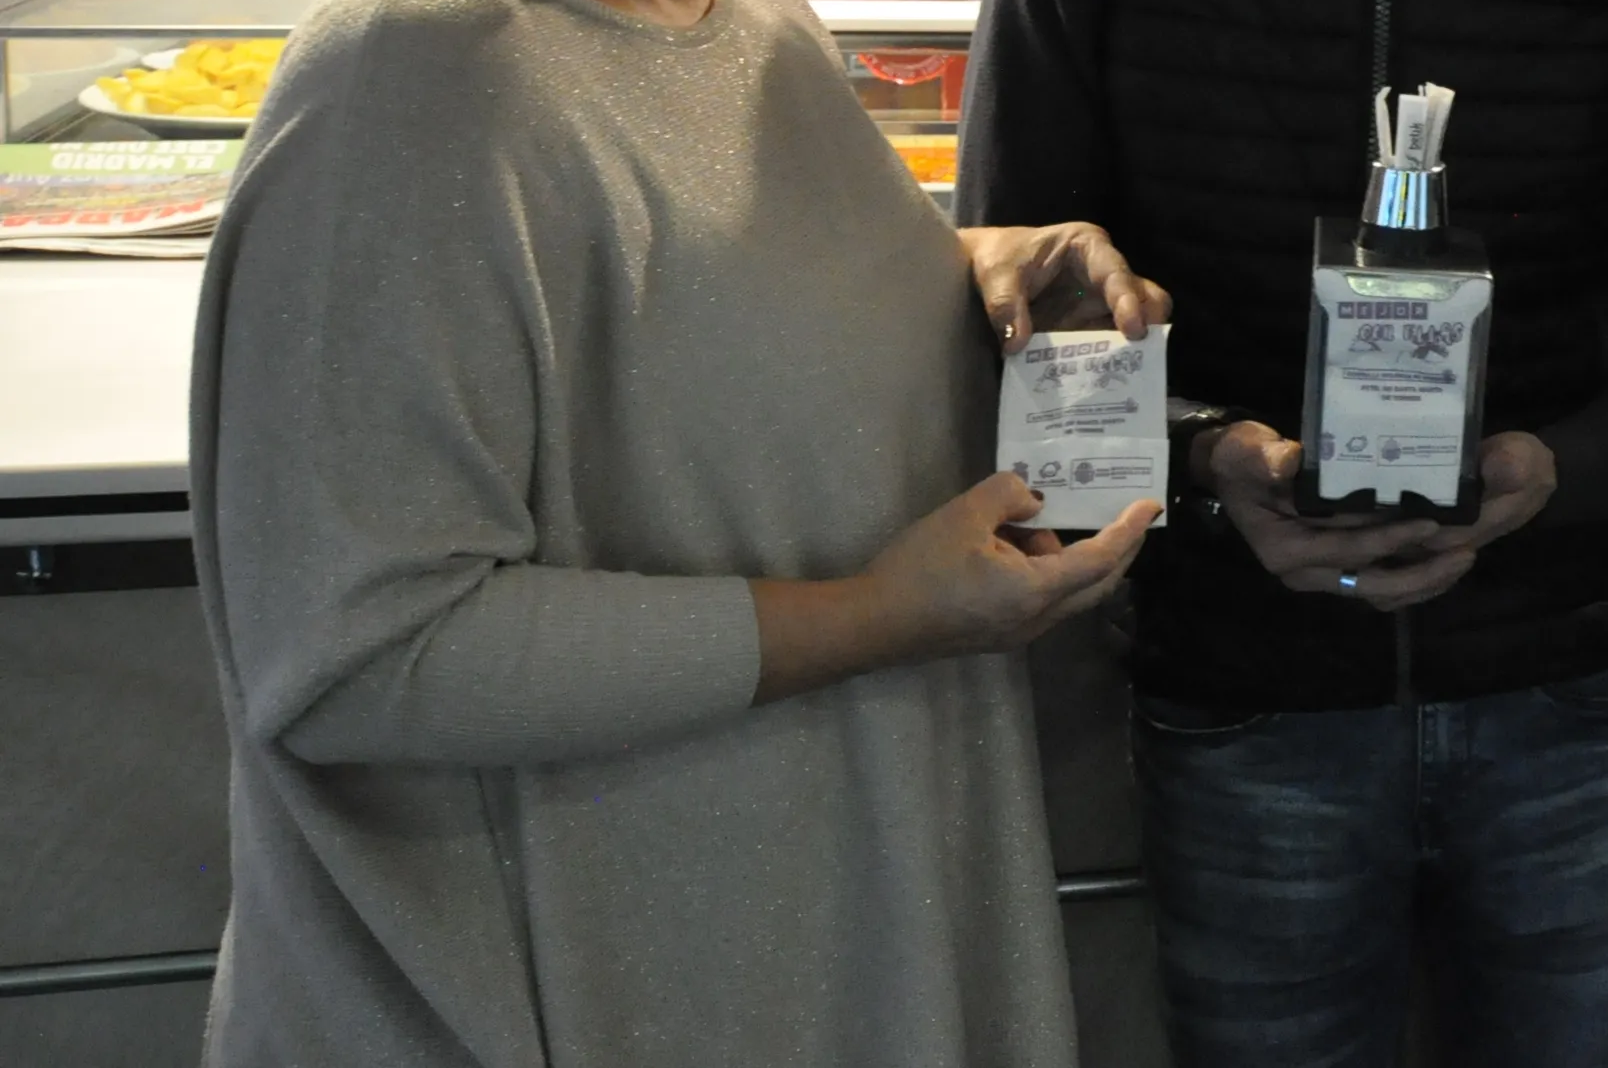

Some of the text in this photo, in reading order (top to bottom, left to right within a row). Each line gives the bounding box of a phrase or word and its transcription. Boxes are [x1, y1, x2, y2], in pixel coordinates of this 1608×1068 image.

[51, 152, 215, 170] EL MADRID
[1338, 302, 1428, 319] MEJOR
